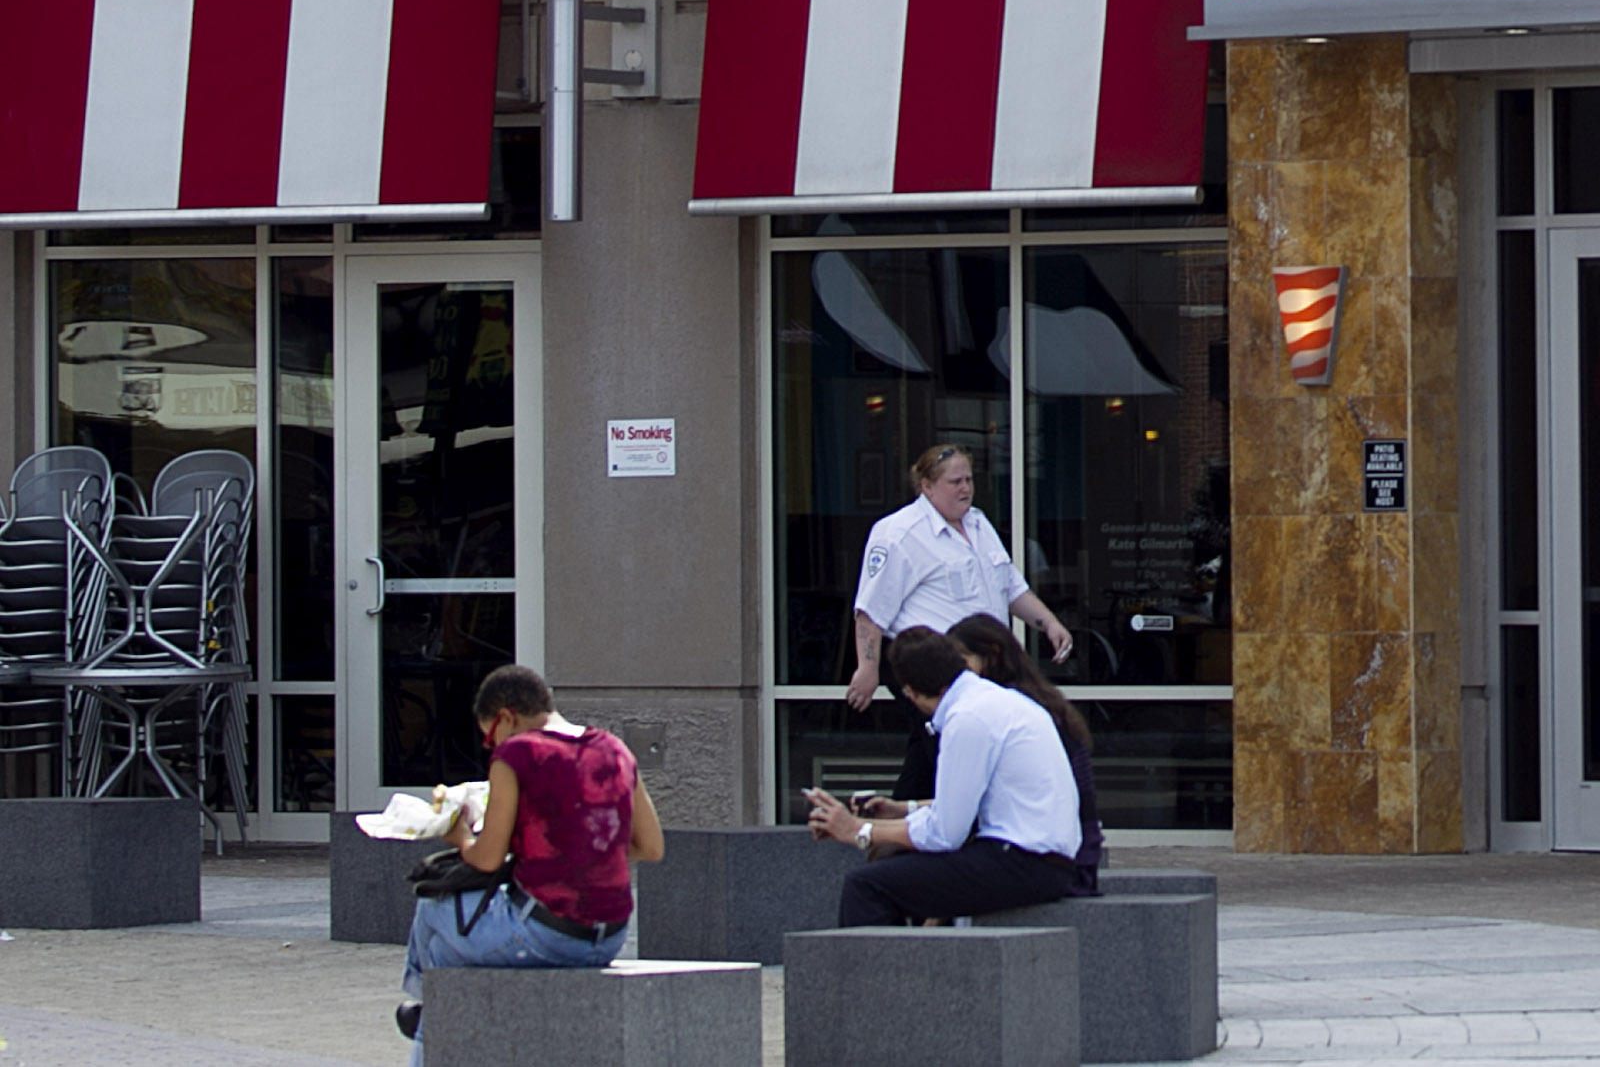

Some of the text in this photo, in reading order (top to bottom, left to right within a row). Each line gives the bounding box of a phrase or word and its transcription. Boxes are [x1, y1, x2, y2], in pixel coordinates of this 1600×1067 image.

[611, 425, 672, 442] No Smoking
[1108, 538, 1194, 550] Kate Gilmartin
